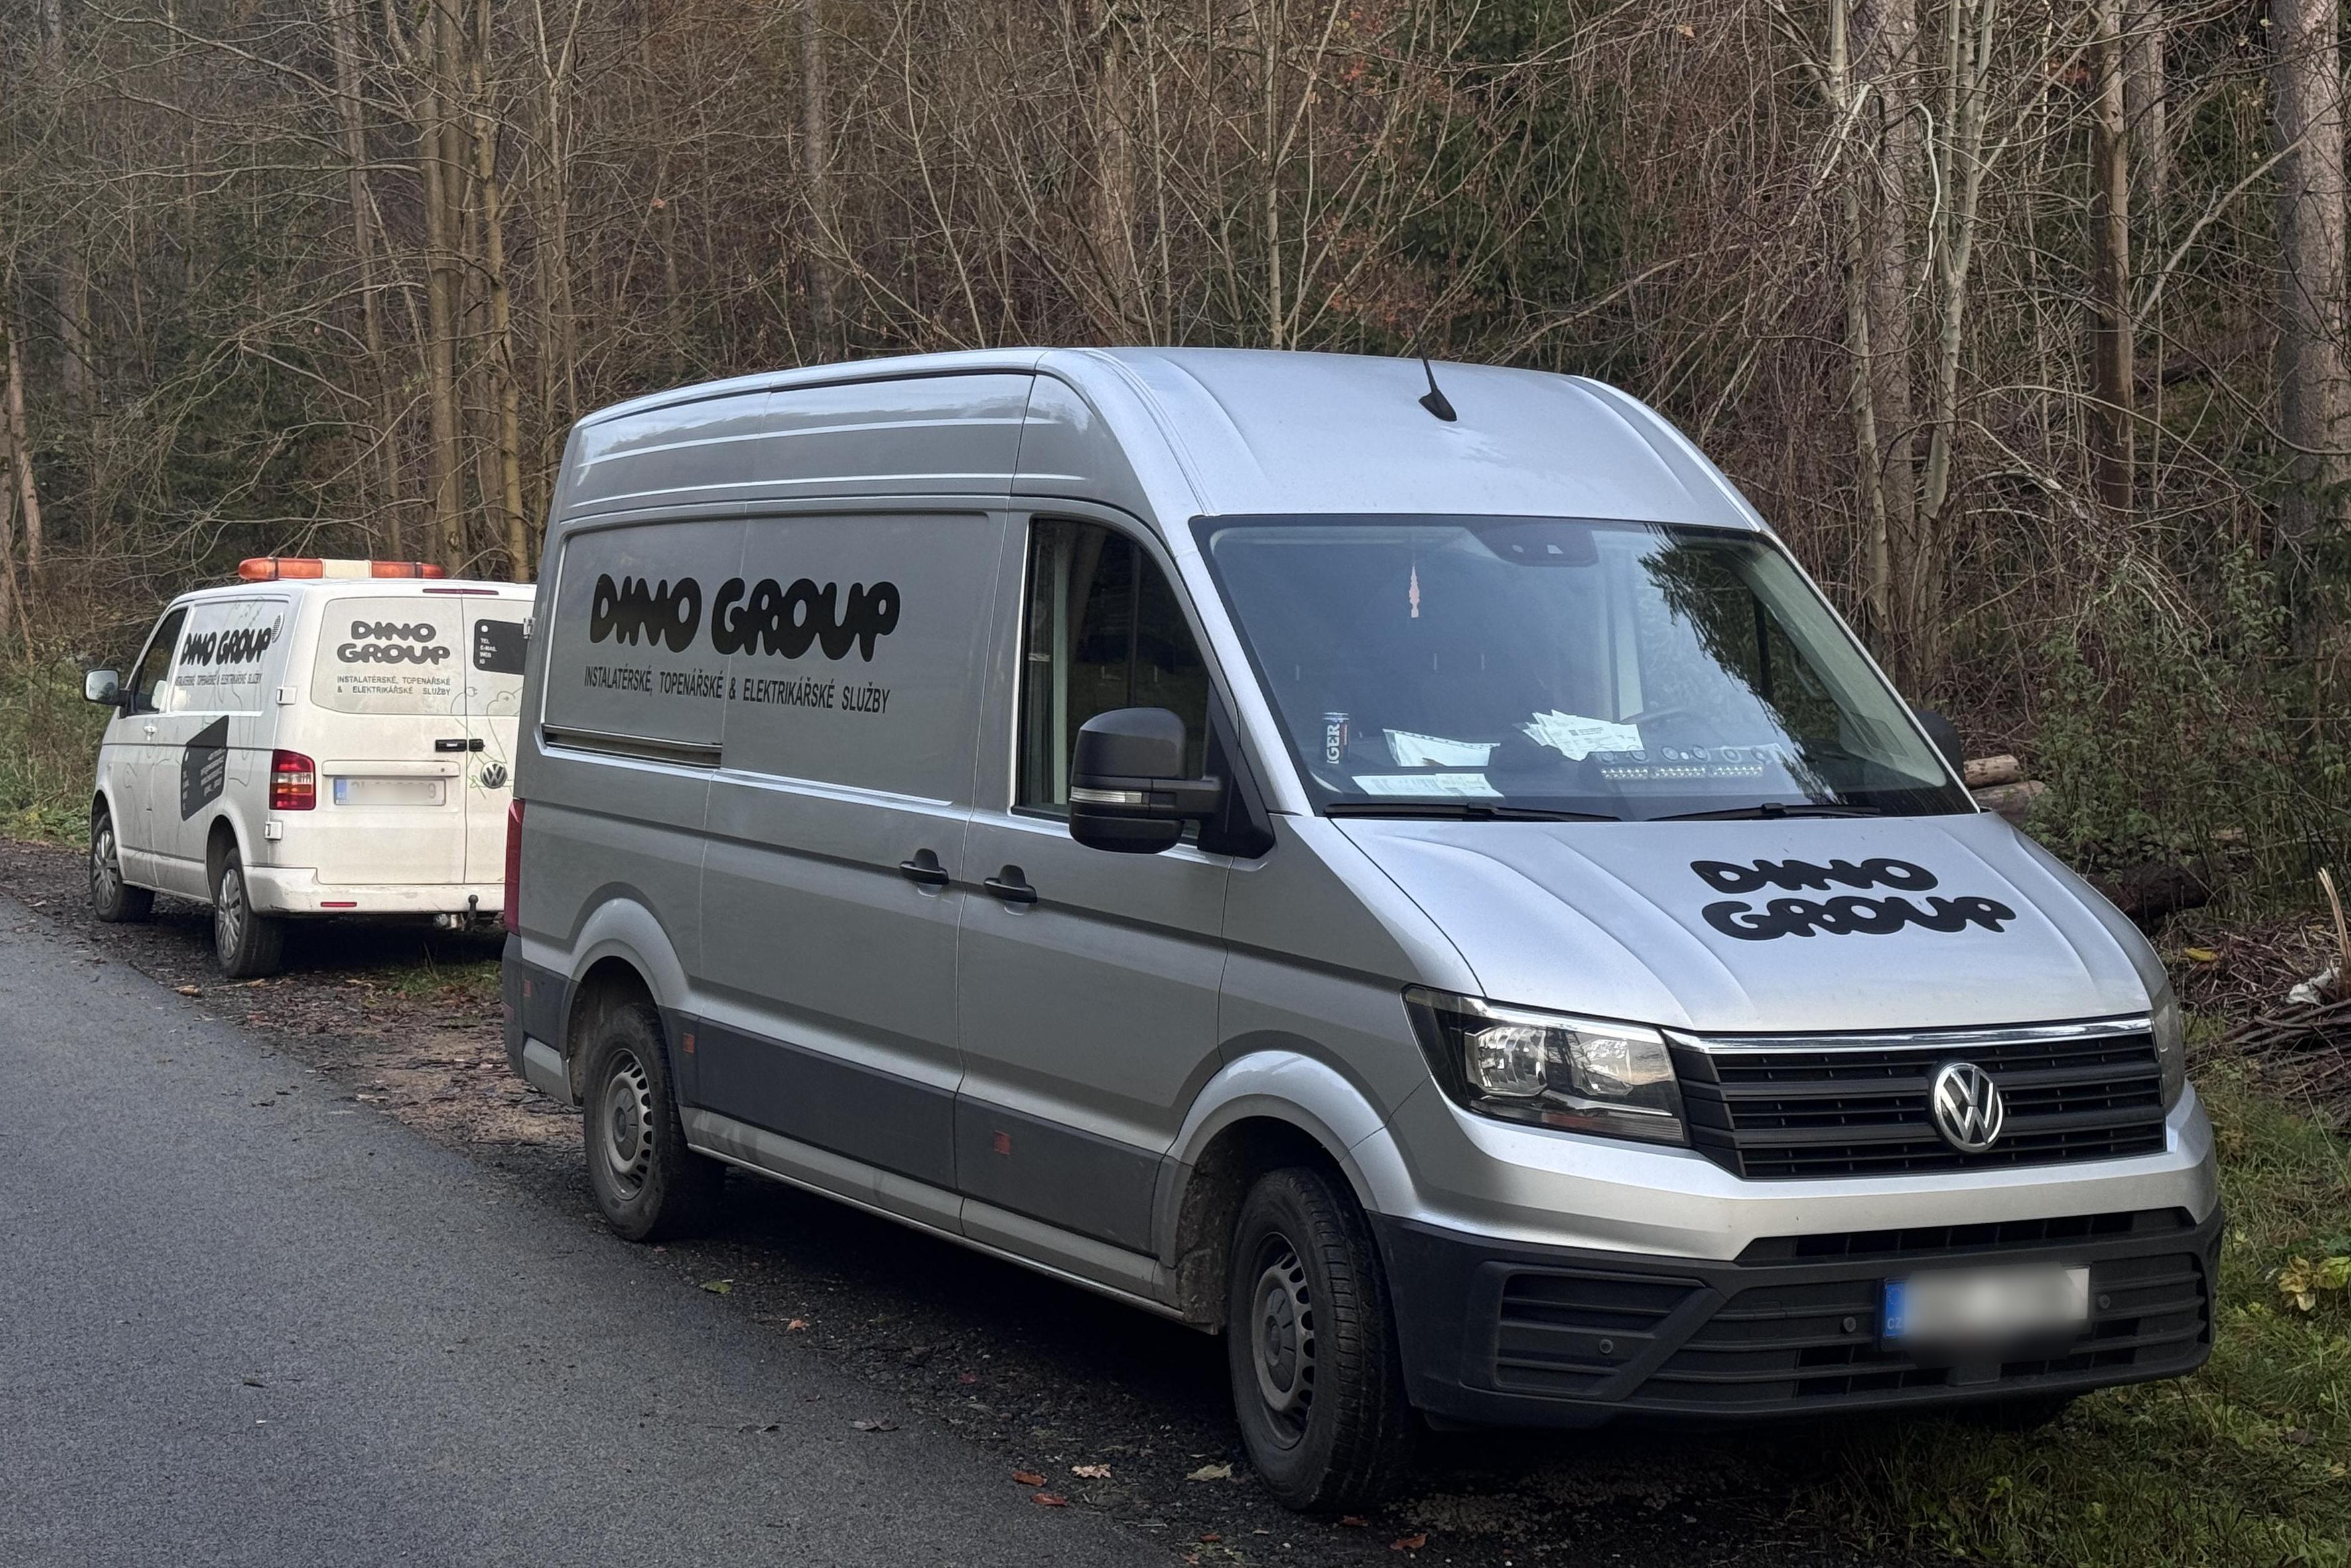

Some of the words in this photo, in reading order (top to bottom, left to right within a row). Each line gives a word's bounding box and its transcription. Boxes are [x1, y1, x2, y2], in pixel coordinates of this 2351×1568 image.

[351, 620, 437, 643] DINO
[590, 573, 702, 653] DINO
[711, 578, 900, 663] GROUP
[180, 631, 216, 667] DINO
[216, 627, 272, 665] GROUP
[337, 643, 450, 665] GROUP
[423, 686, 450, 696] SLUŽBY
[584, 663, 652, 696] INSTALATÉRSKÉ,
[660, 668, 723, 698] TOPENÁŘSKÉ
[729, 677, 736, 700] &
[743, 676, 835, 709] ELEKTRIKÁŘSKÉ
[842, 682, 890, 714] SLUŽBY
[1690, 858, 1938, 893] DINO
[1702, 896, 2017, 941] GROUP
